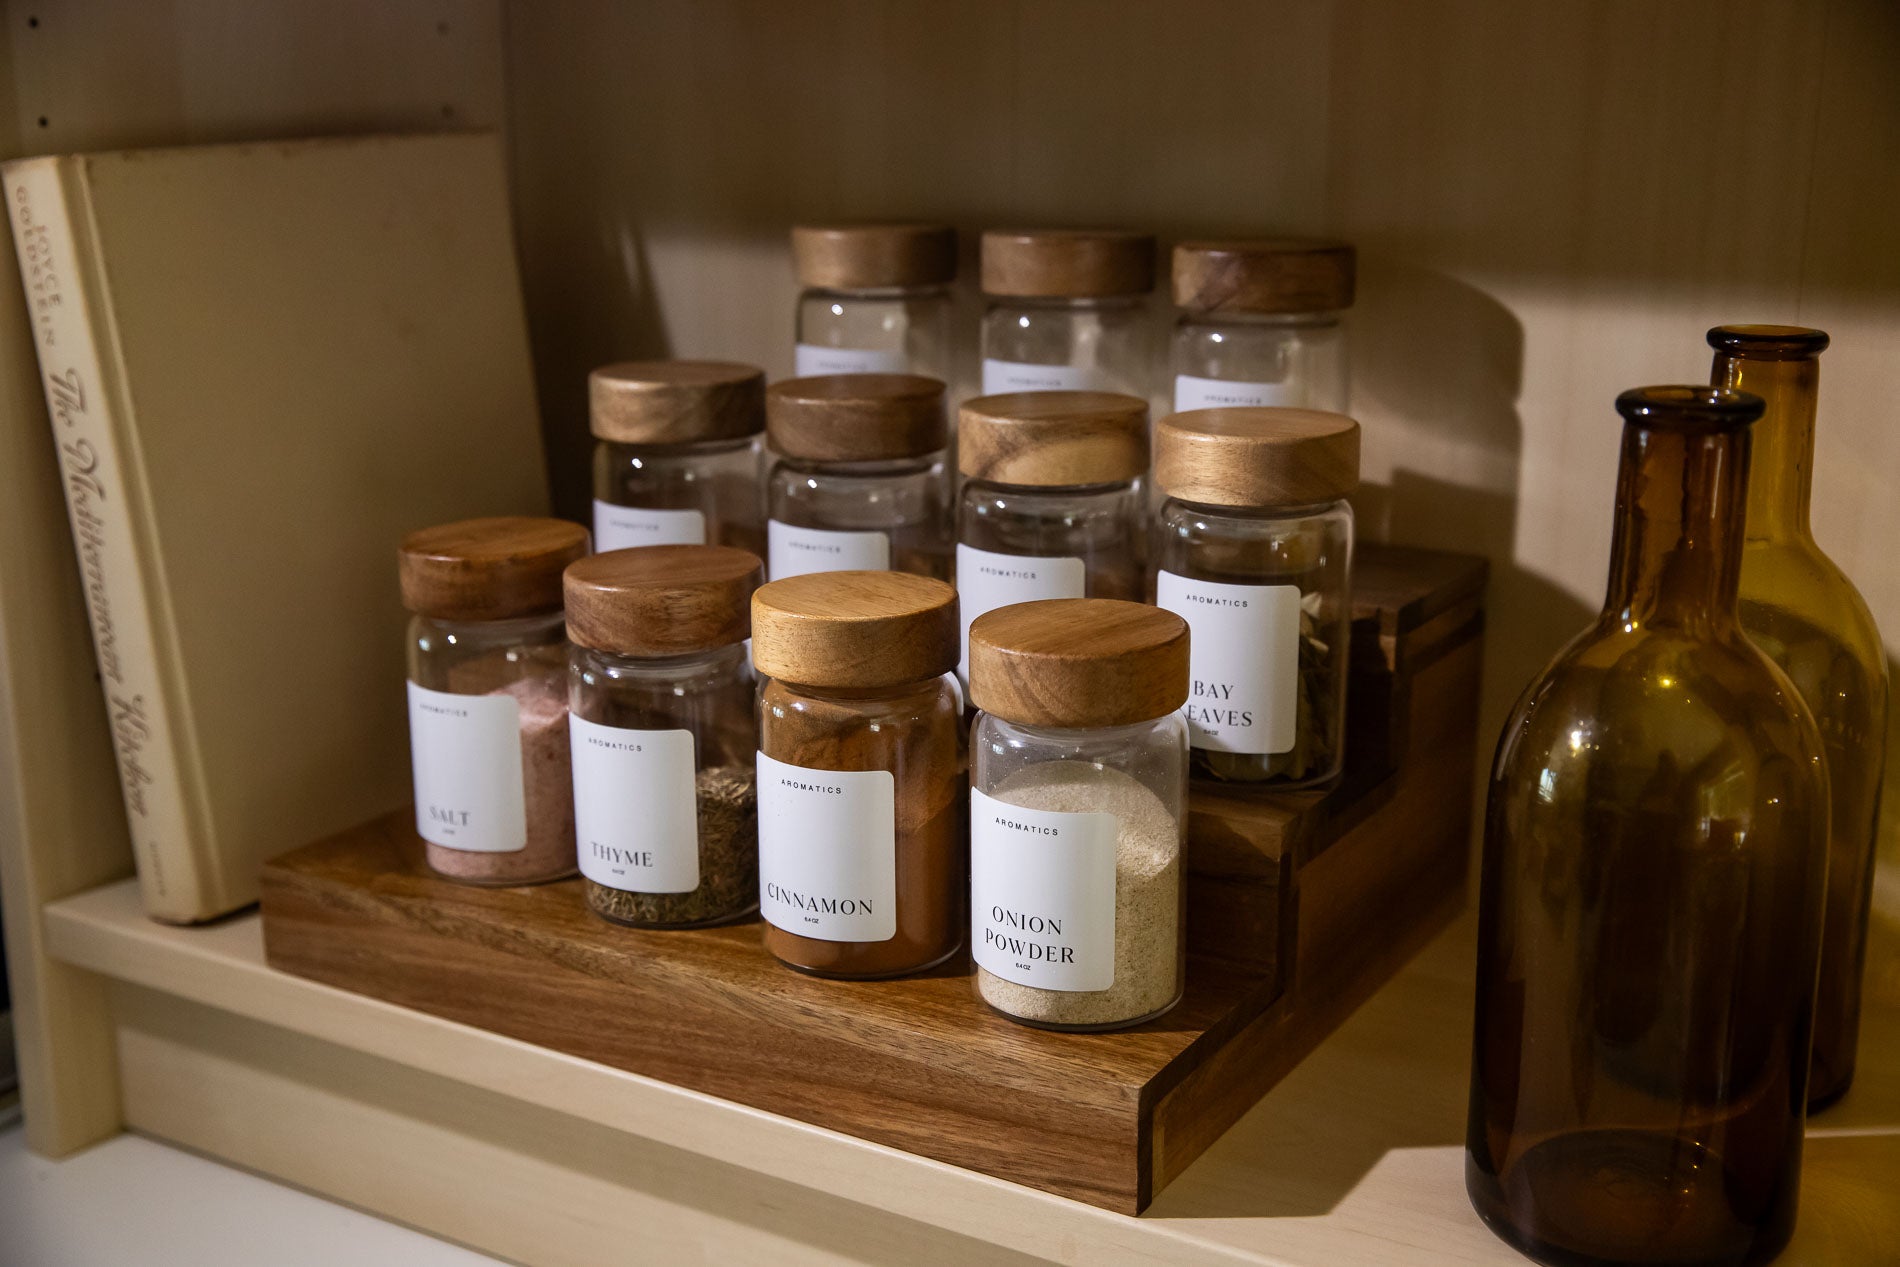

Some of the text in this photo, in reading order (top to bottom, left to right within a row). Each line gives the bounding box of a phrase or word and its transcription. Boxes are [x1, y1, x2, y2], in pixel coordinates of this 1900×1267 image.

[33, 224, 62, 306] JOYCE
[50, 367, 88, 427] The
[111, 695, 154, 817] Kitchen
[1186, 594, 1248, 608] AROMATICS
[1194, 680, 1234, 700] BAY
[1186, 704, 1253, 727] EAVES
[588, 738, 643, 752] AROMATICS
[781, 779, 842, 794] AROMATICS
[429, 806, 472, 827] SALT
[995, 817, 1059, 836] AROMATICS
[590, 841, 654, 868] THYME
[767, 882, 874, 916] CINNAMON
[992, 905, 1062, 936] ONION
[985, 927, 1075, 964] POWDER
